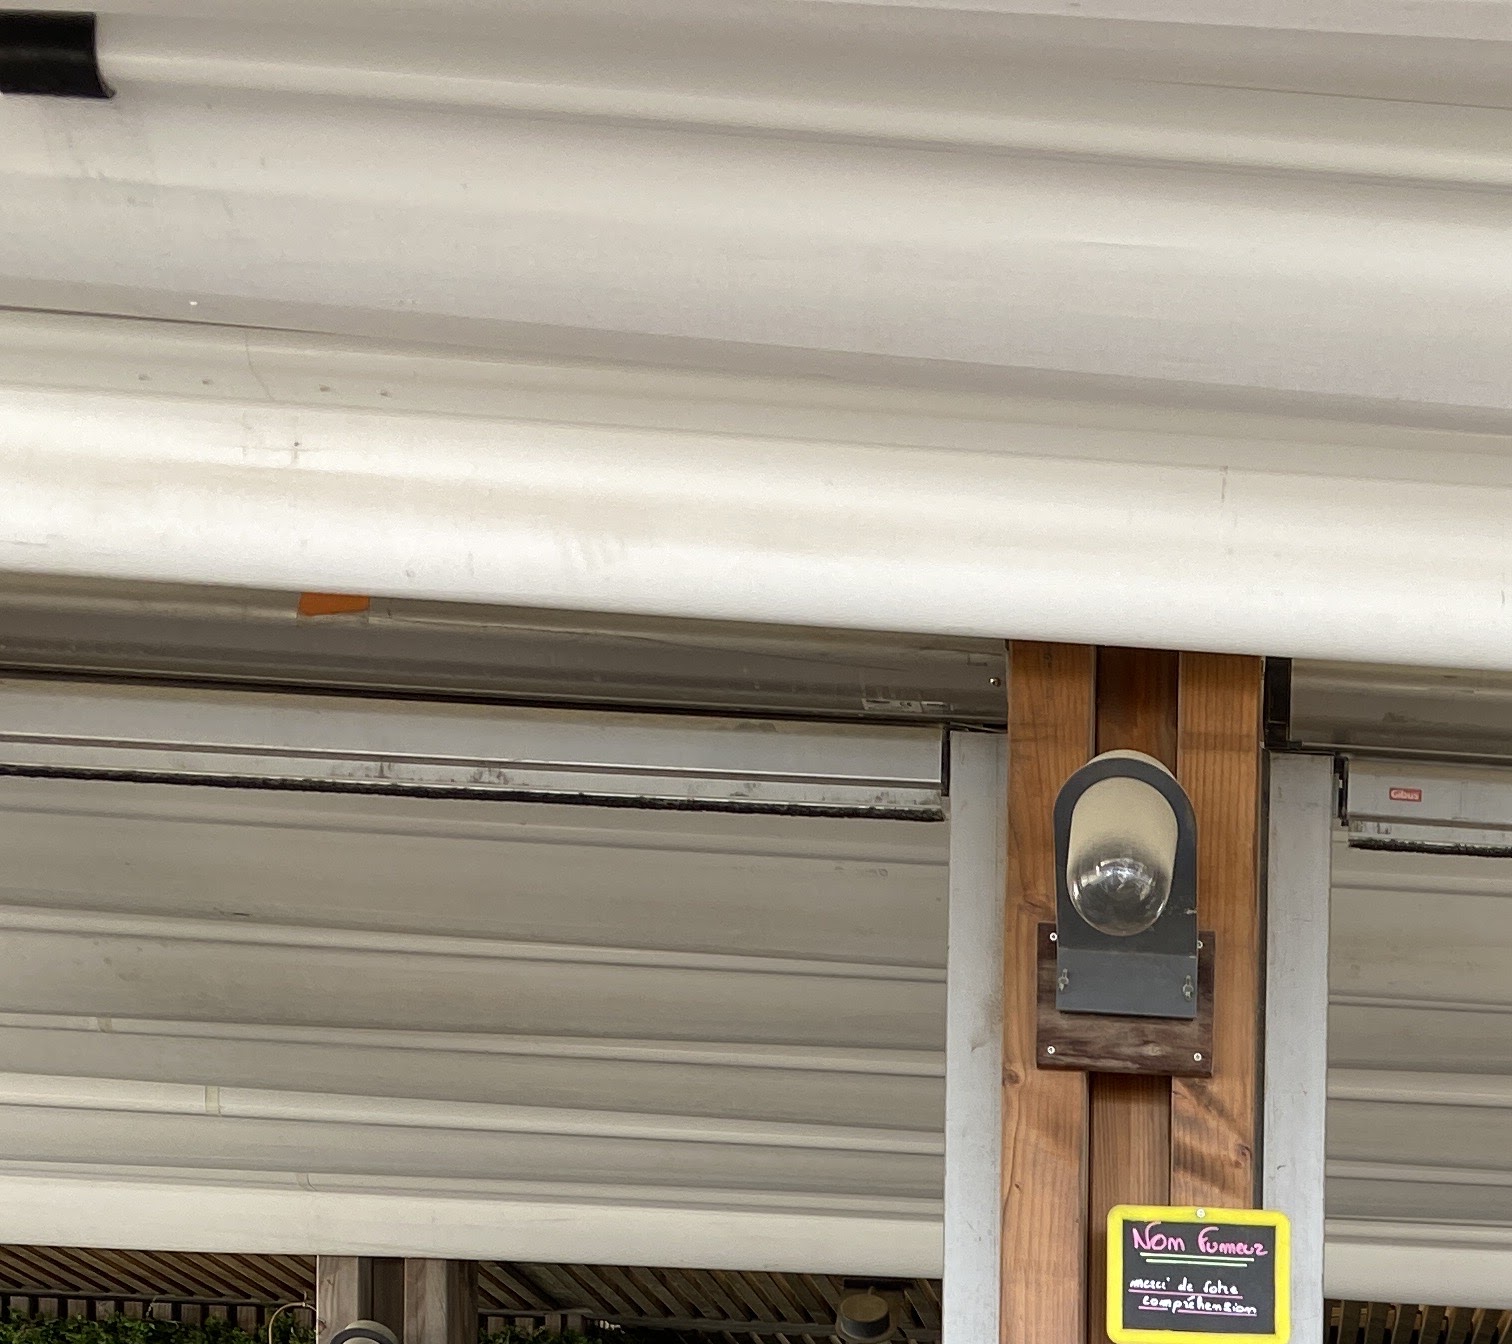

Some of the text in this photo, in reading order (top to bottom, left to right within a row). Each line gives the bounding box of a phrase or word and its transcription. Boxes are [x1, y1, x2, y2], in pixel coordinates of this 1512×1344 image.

[1390, 789, 1420, 800] Gibus
[1178, 1276, 1194, 1292] de
[1142, 1295, 1257, 1314] compréhension
